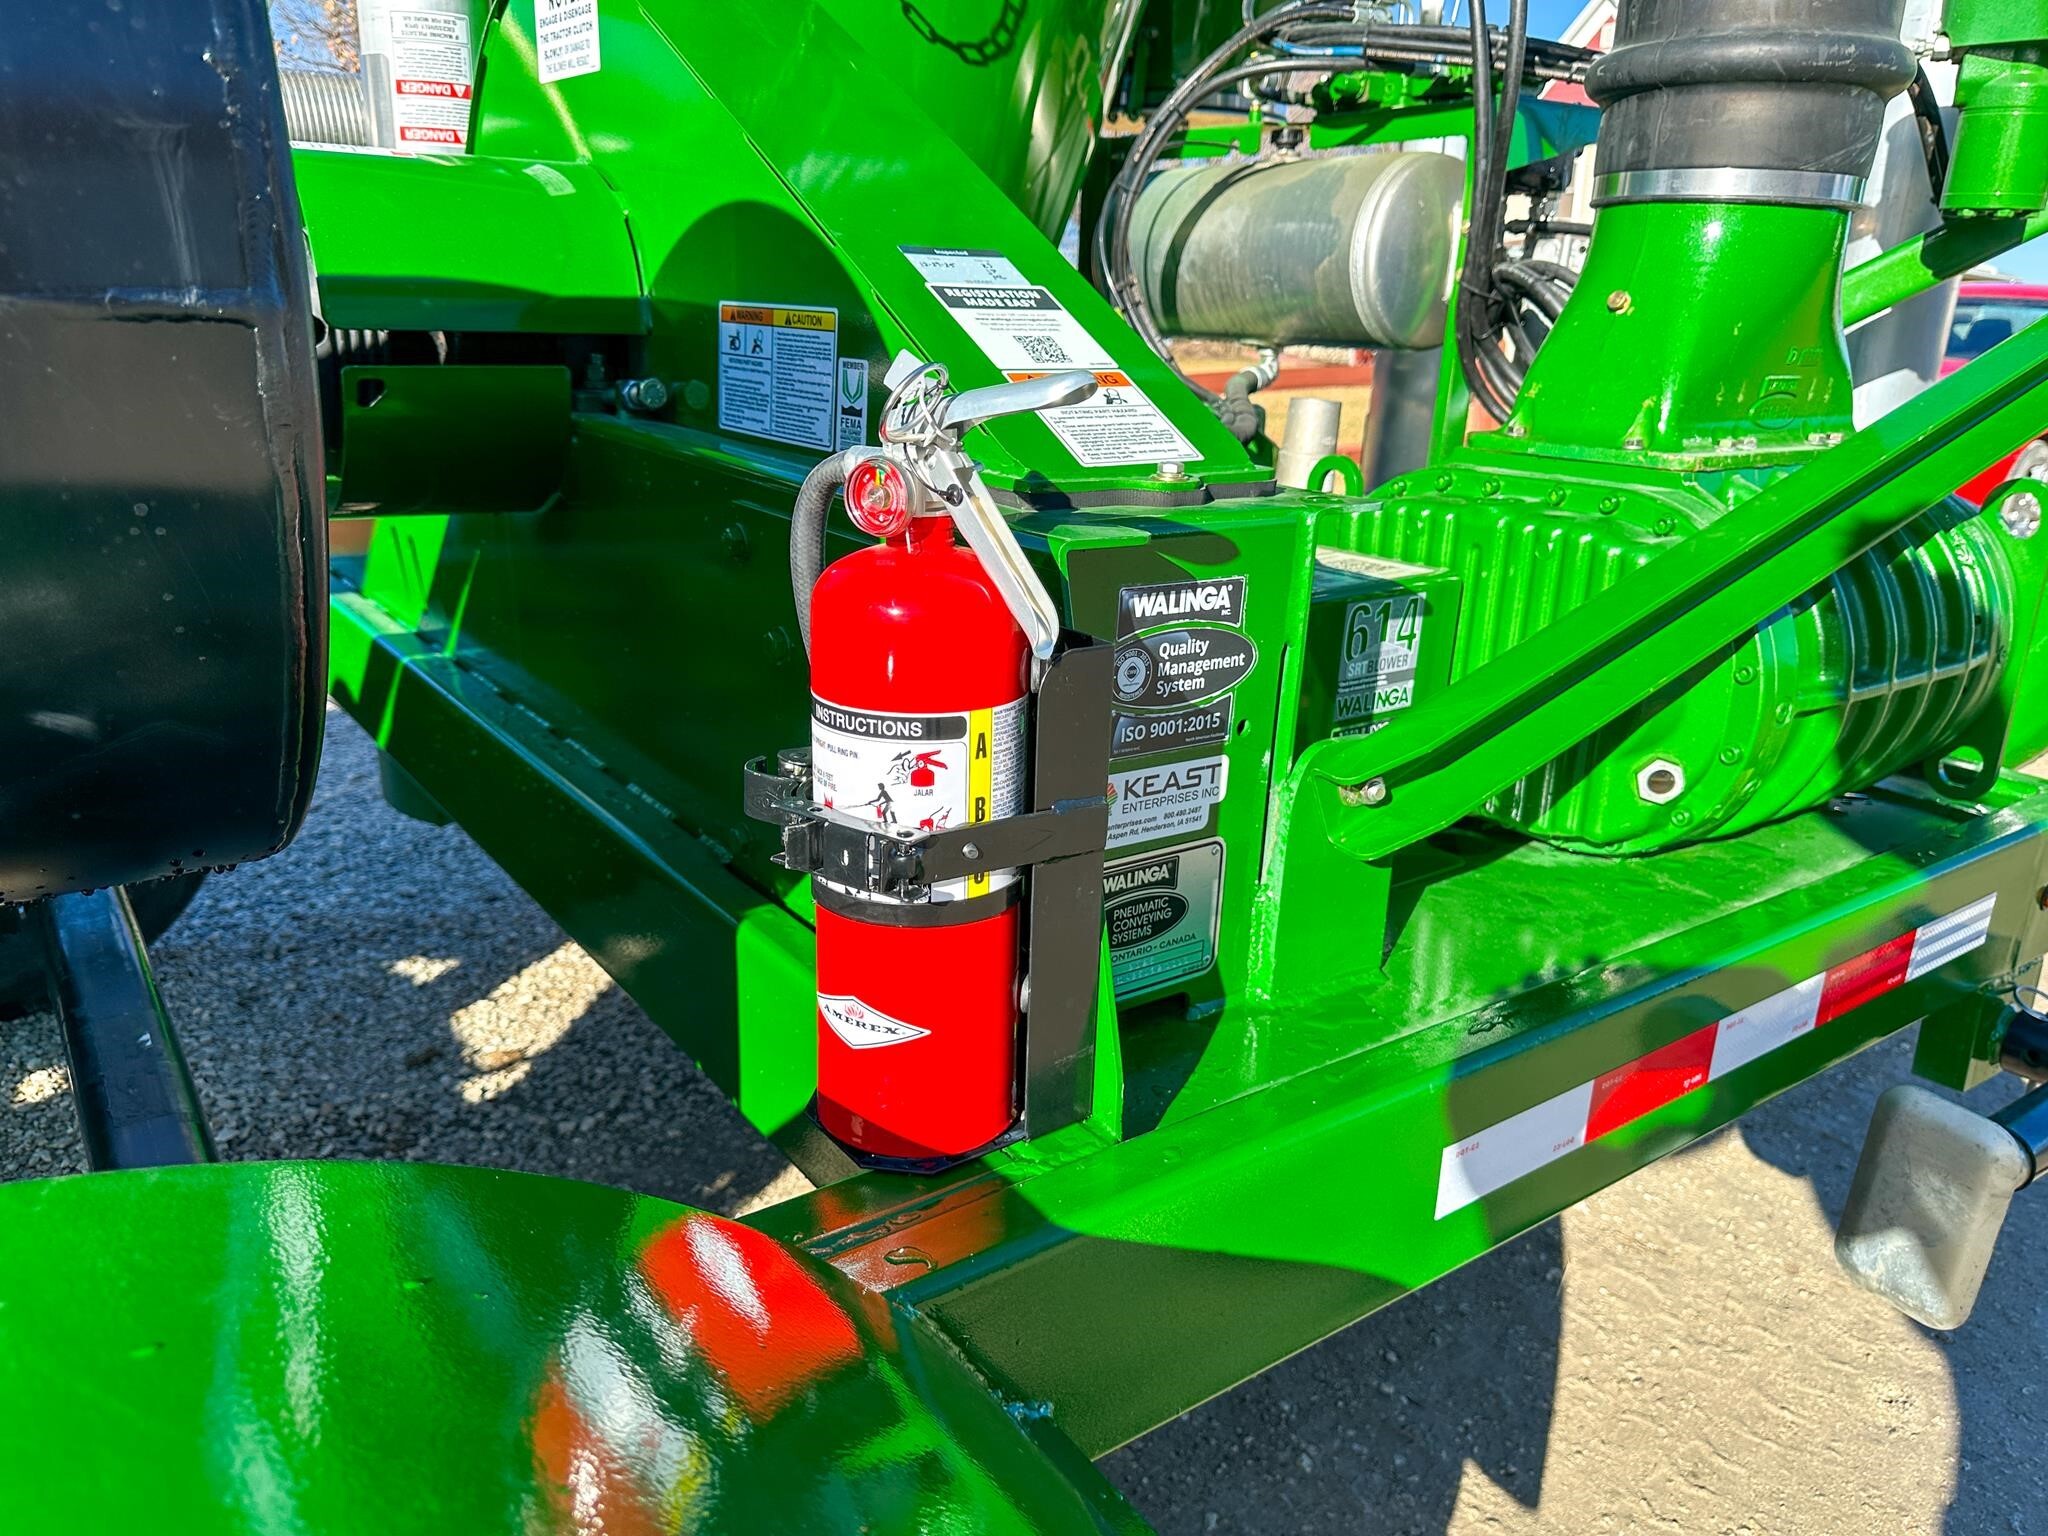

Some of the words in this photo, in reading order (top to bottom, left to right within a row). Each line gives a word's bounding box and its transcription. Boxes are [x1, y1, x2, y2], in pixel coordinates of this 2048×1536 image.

[400, 81, 452, 96] DANGER
[404, 128, 455, 142] DANGER
[943, 288, 1041, 299] REGISTRATION
[962, 298, 1004, 306] MADE
[1004, 299, 1037, 307] EASY
[737, 310, 764, 322] WARNING
[792, 314, 822, 326] CAUTION
[840, 418, 862, 430] FEMA
[1344, 595, 1420, 665] 614
[1159, 638, 1209, 660] Quality
[1158, 652, 1245, 677] Management
[1156, 676, 1205, 698] System
[1336, 686, 1409, 718] WALINGA
[816, 703, 923, 737] INSTRUCTIONS
[1121, 725, 1146, 743] ISO
[1150, 712, 1221, 738] 9001:2015
[975, 732, 987, 760] A
[1124, 762, 1222, 800] KEAST
[975, 796, 986, 824] B
[1122, 790, 1199, 814] ENTERPRISES
[1202, 786, 1220, 799] INC
[1108, 830, 1128, 840] Aspen
[1129, 828, 1140, 836] Rd,
[1141, 822, 1175, 834] Henderson,
[1185, 815, 1202, 824] 51541
[1113, 908, 1172, 932] CONVEYING
[1114, 897, 1169, 920] PNEUMATIC
[1112, 925, 1152, 944] SYSTEMS
[1112, 945, 1152, 962] ONTARIO
[1160, 933, 1196, 949] CANADA
[824, 1003, 901, 1035] AMEREX
